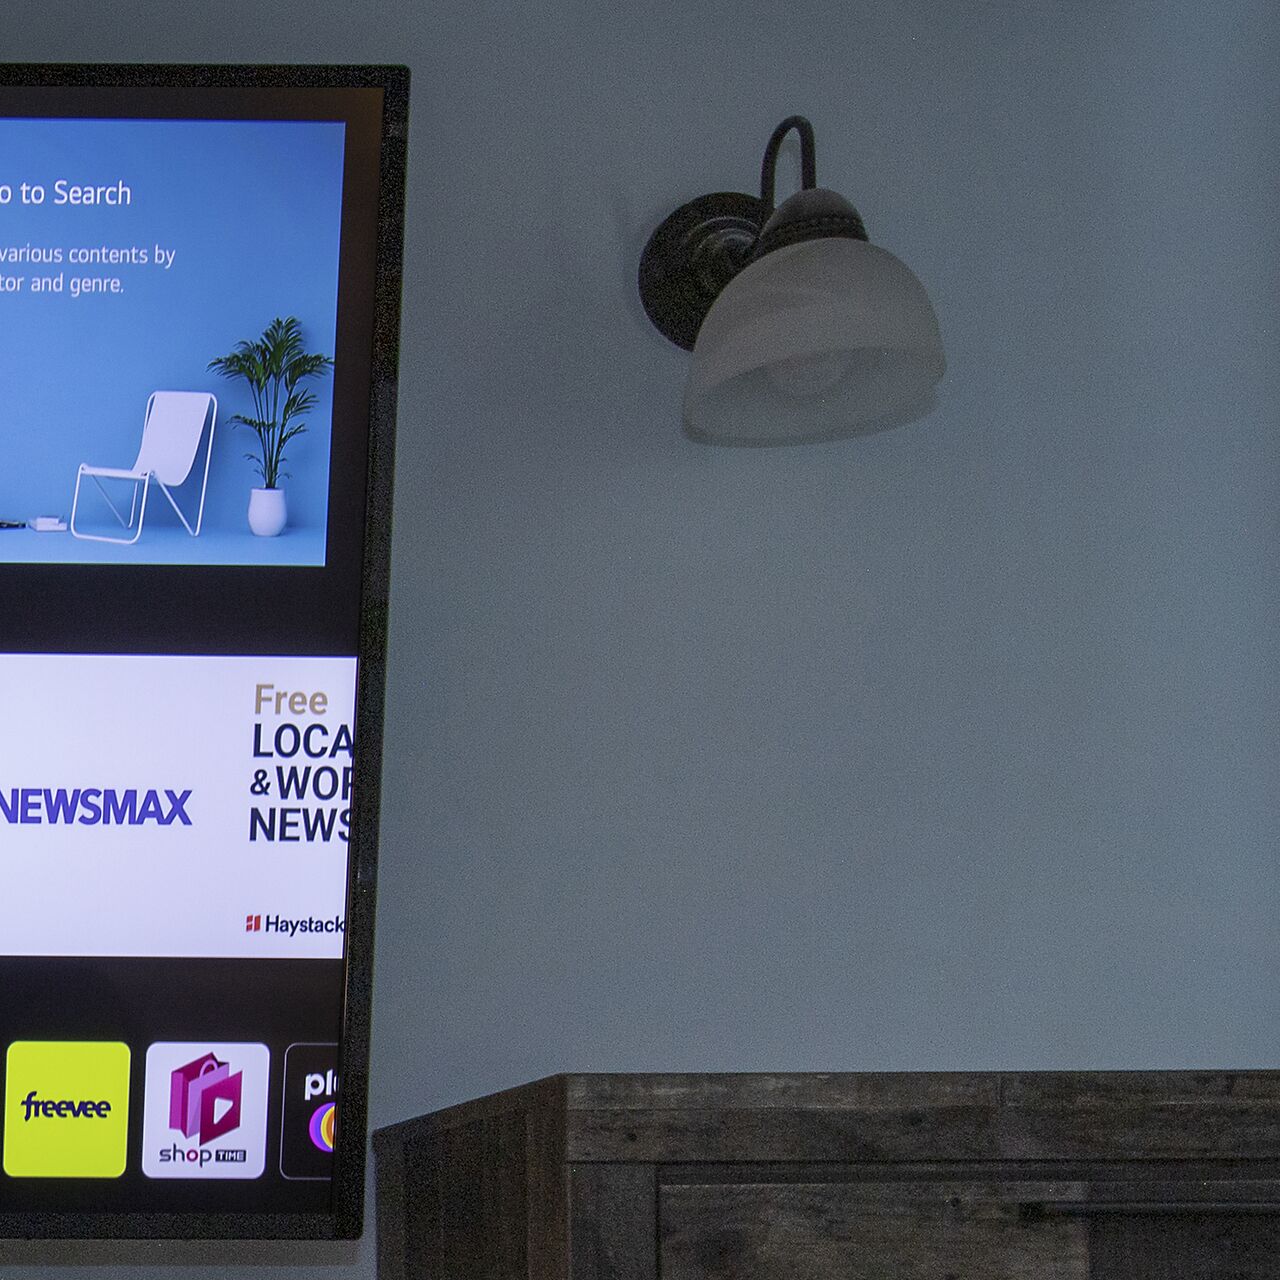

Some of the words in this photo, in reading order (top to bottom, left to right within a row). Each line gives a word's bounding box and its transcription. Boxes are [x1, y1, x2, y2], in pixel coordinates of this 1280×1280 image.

[20, 182, 45, 205] to
[54, 180, 131, 206] Search
[69, 245, 148, 265] contents
[154, 245, 176, 269] by
[31, 273, 64, 293] and
[70, 277, 124, 297] genre.
[254, 683, 328, 715] Free
[249, 768, 272, 796] &
[304, 1068, 339, 1101] pl
[21, 1090, 112, 1122] freevee
[159, 1143, 212, 1169] shop
[217, 1150, 245, 1162] TIME
